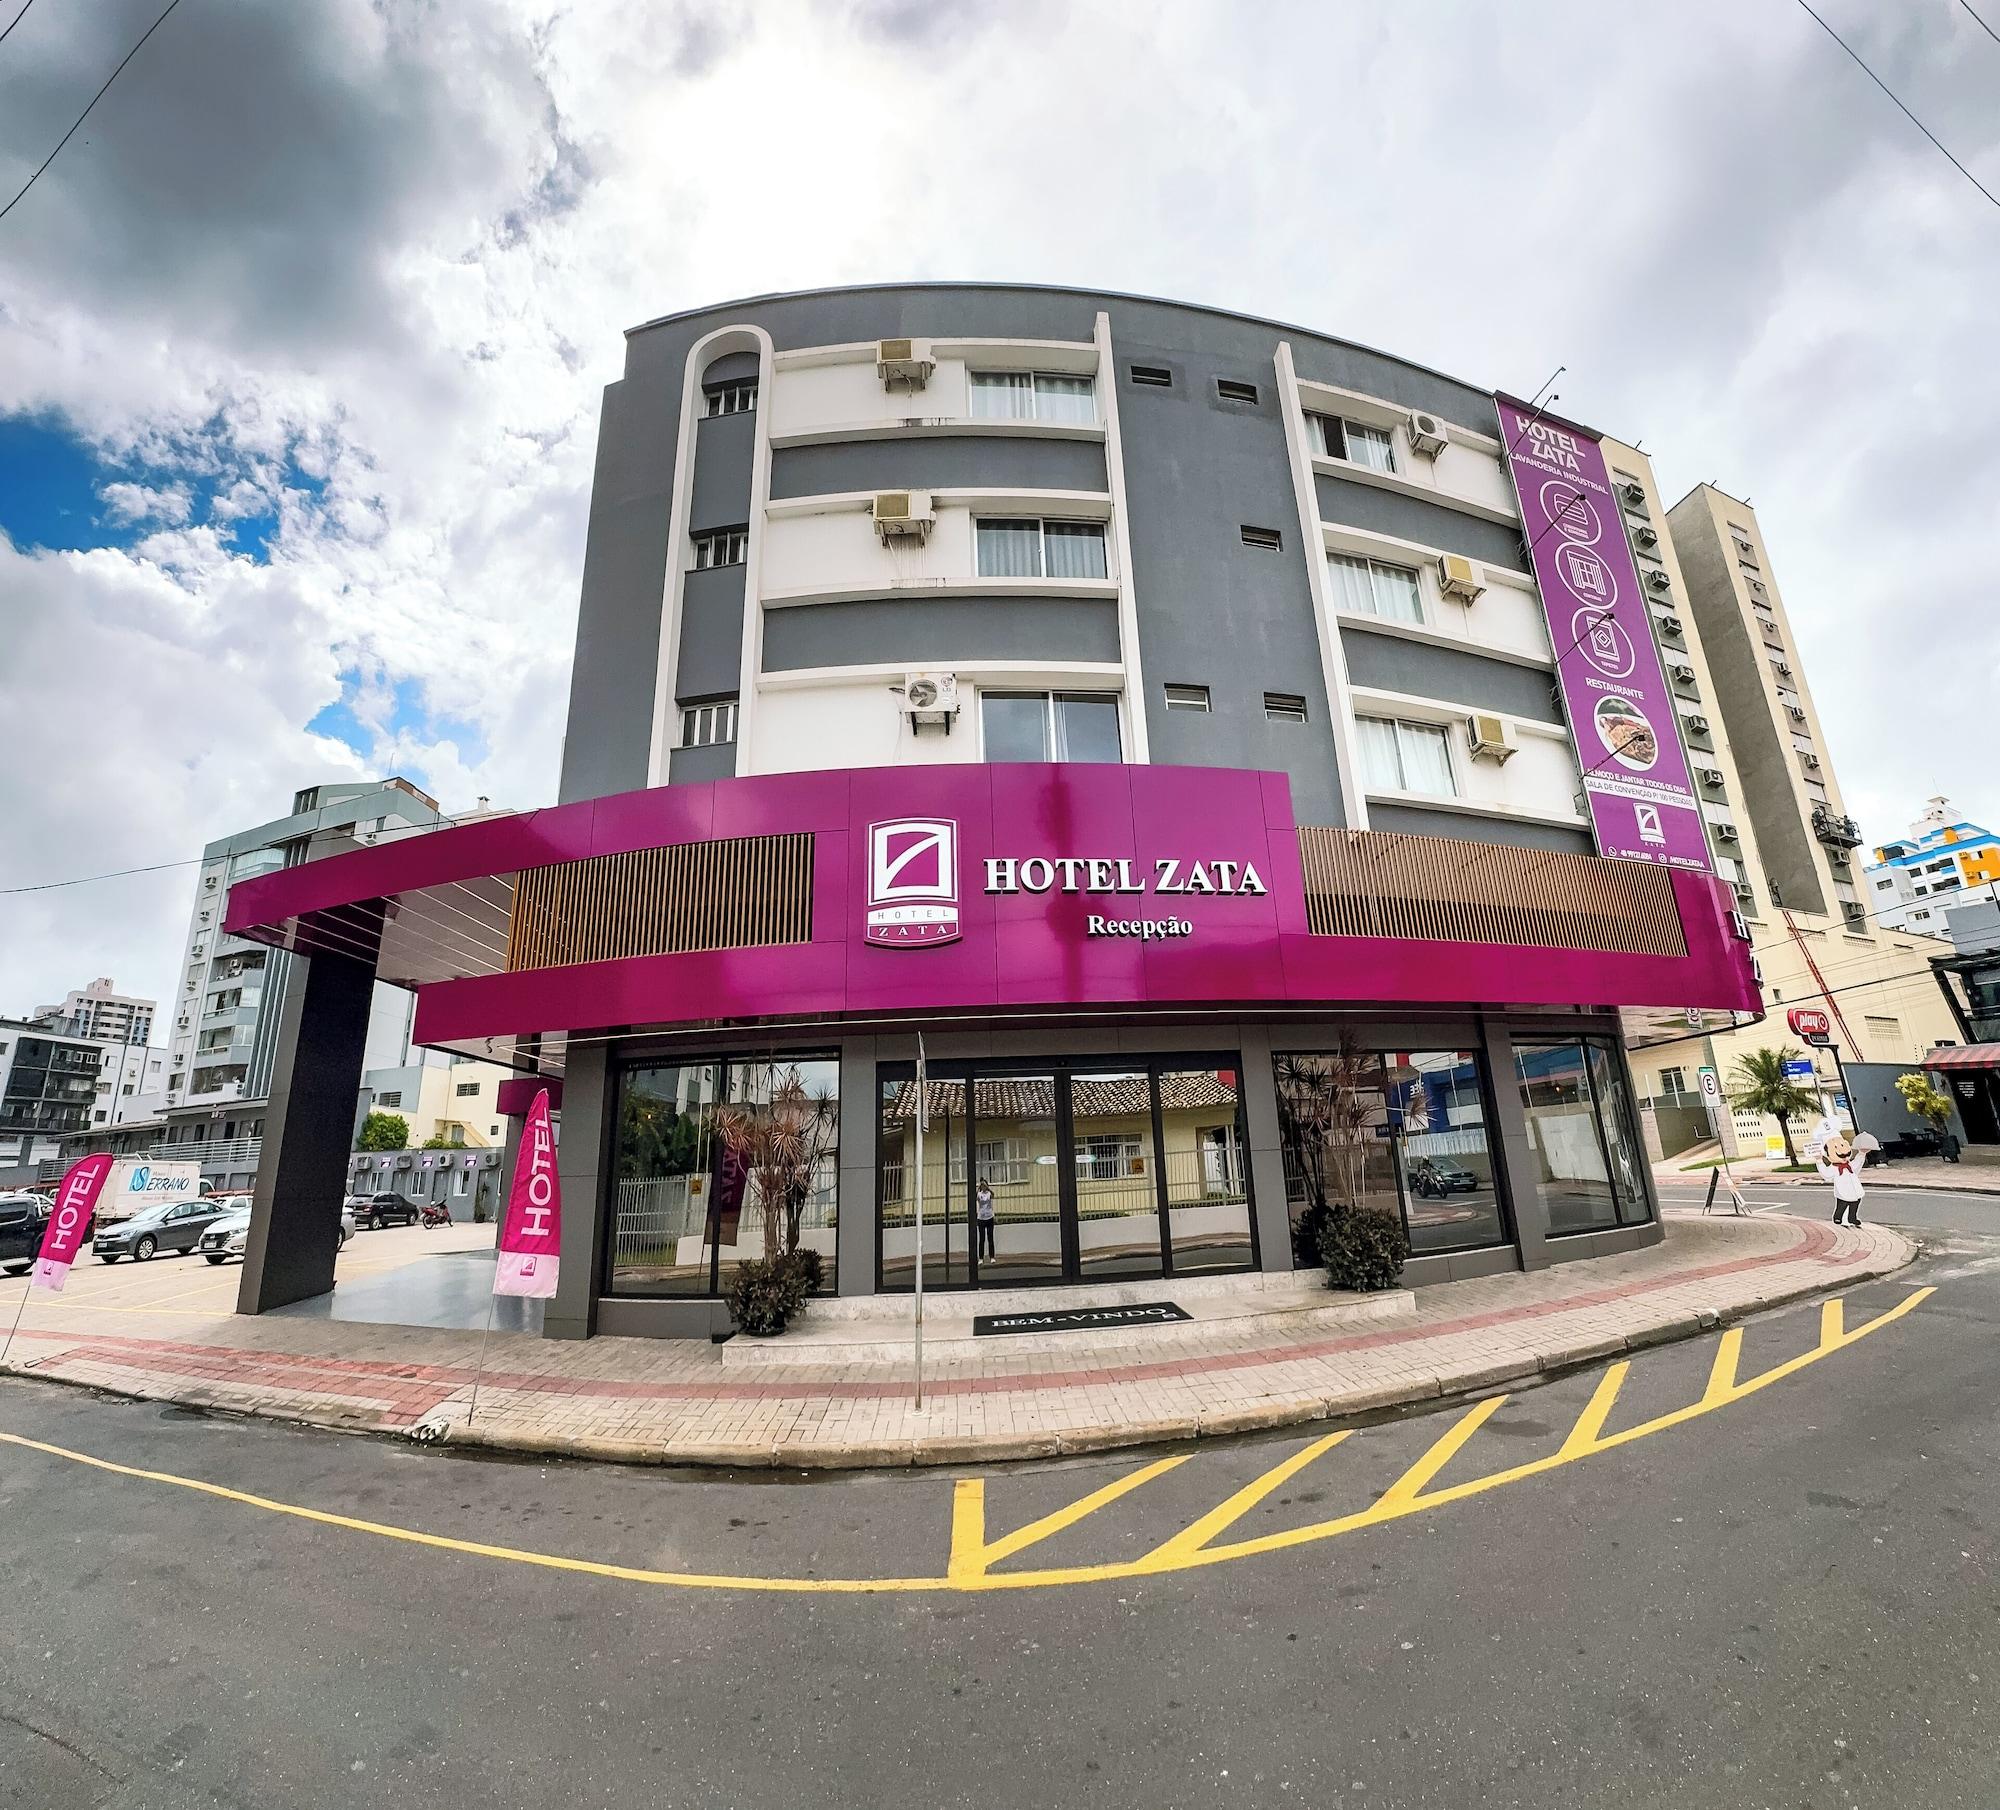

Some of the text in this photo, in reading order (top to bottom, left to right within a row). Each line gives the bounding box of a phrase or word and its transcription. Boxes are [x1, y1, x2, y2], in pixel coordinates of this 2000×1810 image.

[1515, 415, 1586, 457] HOTEL
[1529, 438, 1580, 472] ZATA
[1510, 452, 1608, 495] LAVANDERIA INDUSTRIAL
[1586, 677, 1644, 700] RESTAURANTE
[1586, 780, 1603, 789] SALA
[1604, 783, 1614, 791] DE
[1620, 774, 1645, 785] JANTAR
[1645, 778, 1664, 789] TODOS
[1664, 783, 1673, 791] OS
[983, 858, 1268, 895] HOTEL ZATA
[877, 909, 949, 920] HOTEL
[878, 924, 947, 937] ZATA
[1087, 914, 1194, 941] Recepção
[1799, 1013, 1818, 1030] play
[132, 1166, 190, 1191] SERRANO
[521, 1107, 552, 1236] HOTEL
[51, 1164, 100, 1250] HOTEL
[991, 1308, 1167, 1327] BEM-VINDO
